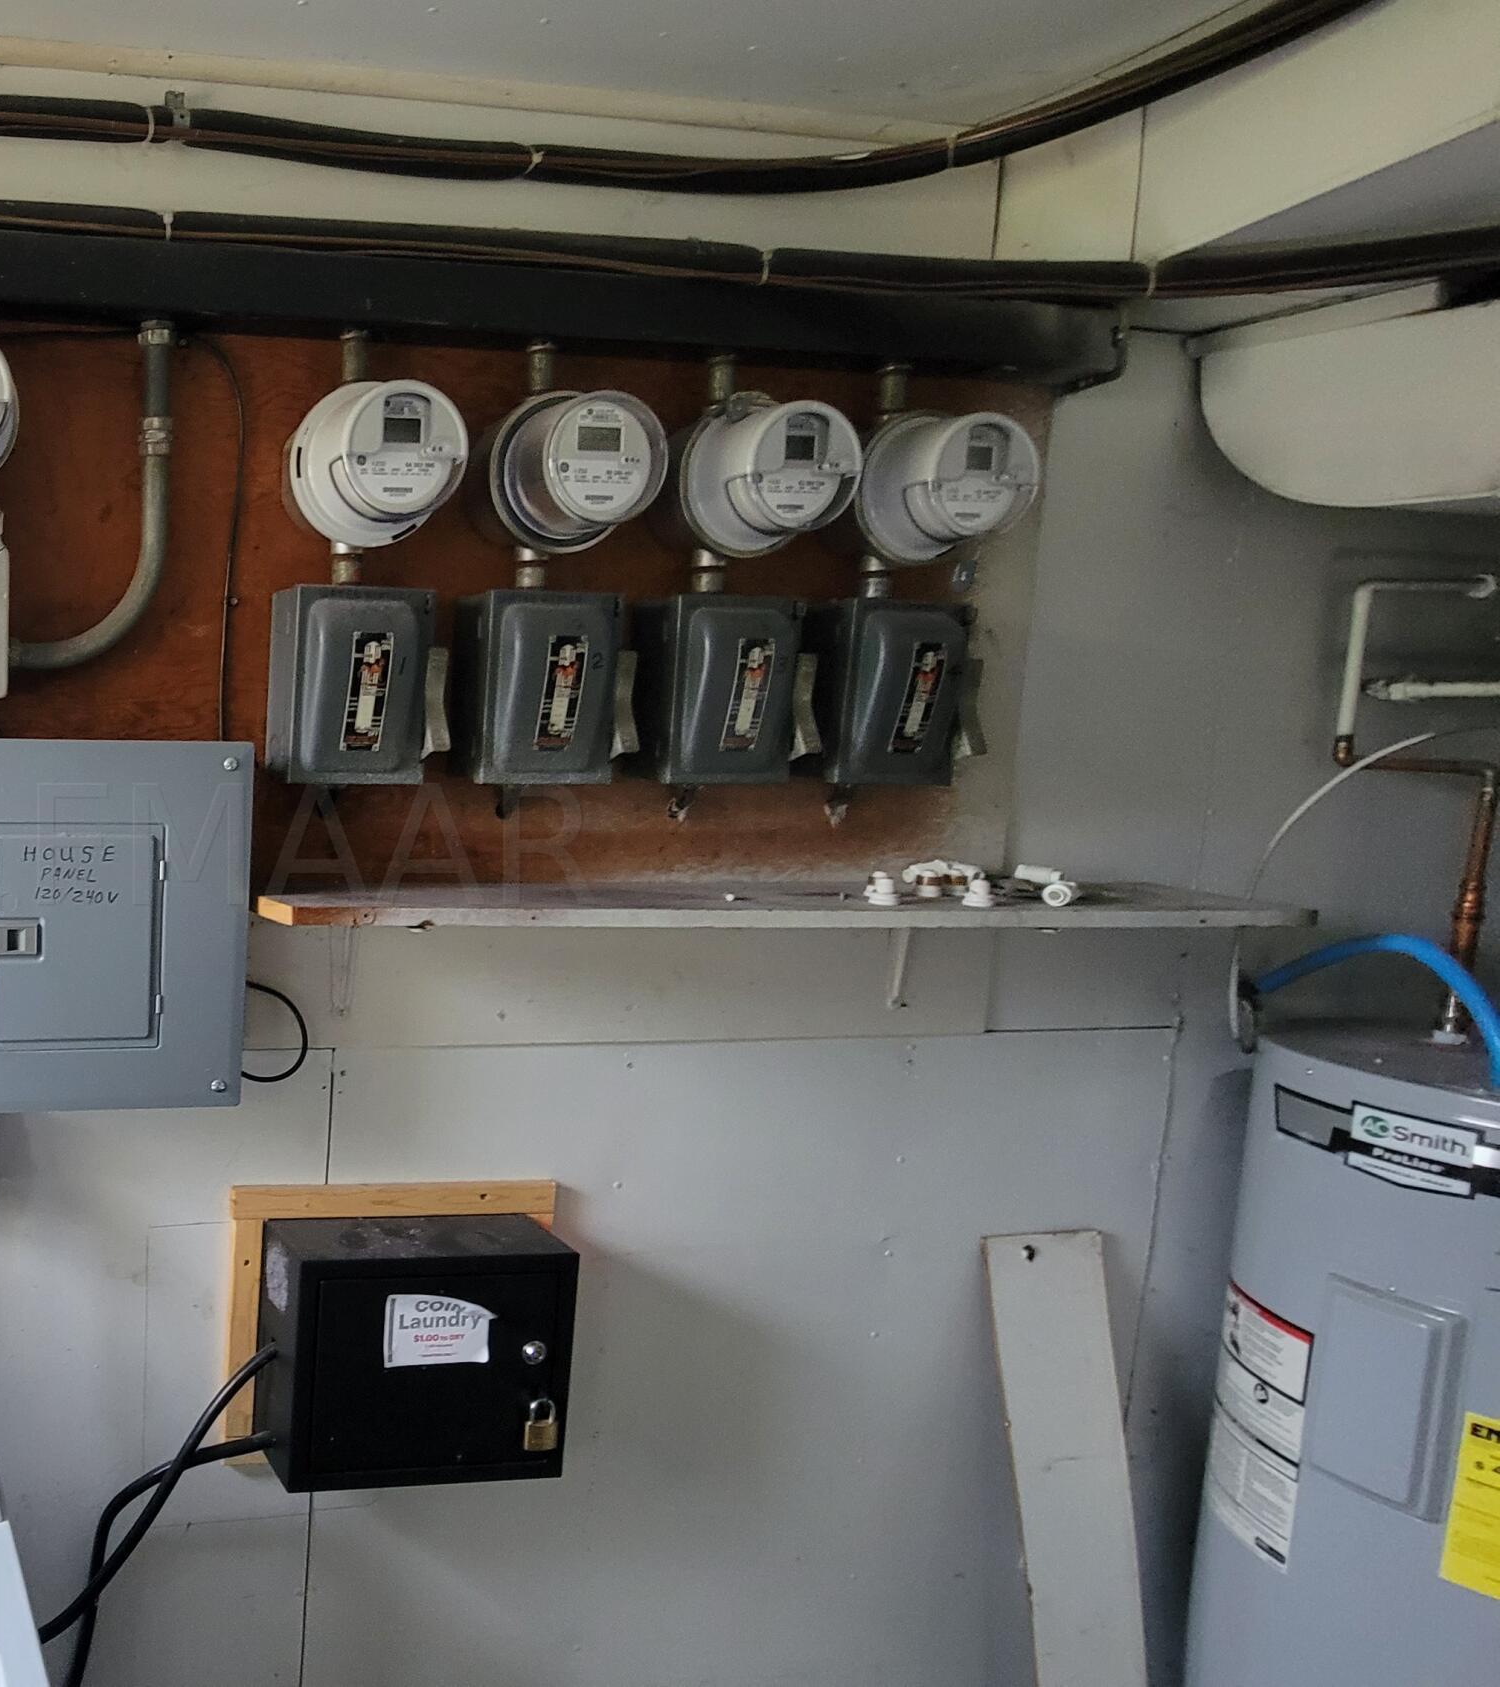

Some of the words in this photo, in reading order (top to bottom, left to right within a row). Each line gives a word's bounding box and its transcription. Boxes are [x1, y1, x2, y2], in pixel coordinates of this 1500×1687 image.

[23, 845, 116, 863] HOUSE
[40, 867, 97, 882] PANEL
[1392, 1125, 1467, 1157] Smith
[1371, 1147, 1445, 1173] ProLine
[398, 1312, 481, 1330] Laundry
[413, 1333, 439, 1343] $1.00
